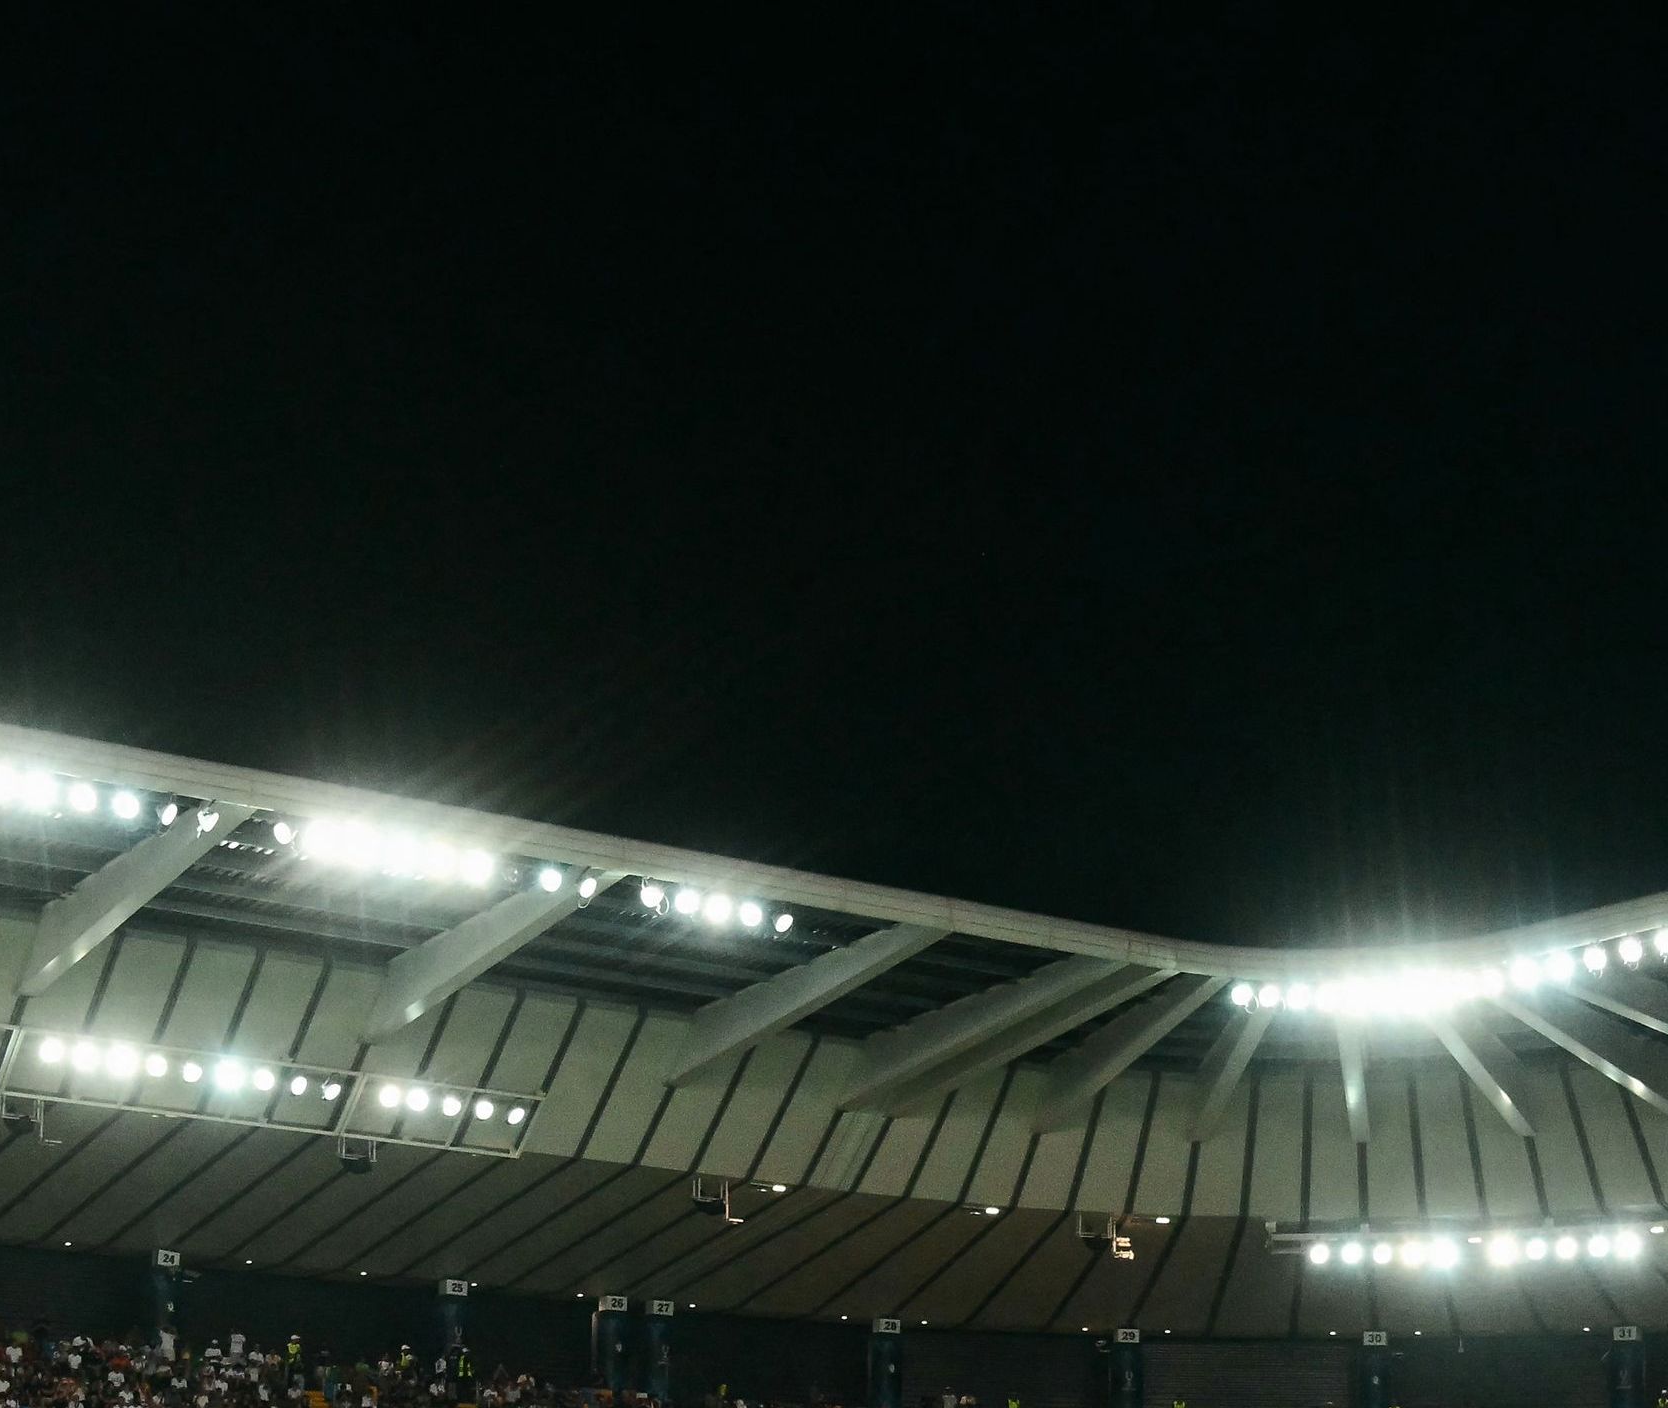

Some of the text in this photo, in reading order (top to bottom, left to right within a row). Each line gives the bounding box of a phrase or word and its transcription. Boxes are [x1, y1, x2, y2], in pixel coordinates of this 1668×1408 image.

[163, 1254, 175, 1264] 24
[451, 1282, 463, 1292] 25
[611, 1298, 624, 1308] 26
[657, 1303, 670, 1313] 27
[1122, 1331, 1135, 1341] 29
[1368, 1333, 1381, 1344] 30
[1619, 1329, 1631, 1338] 31
